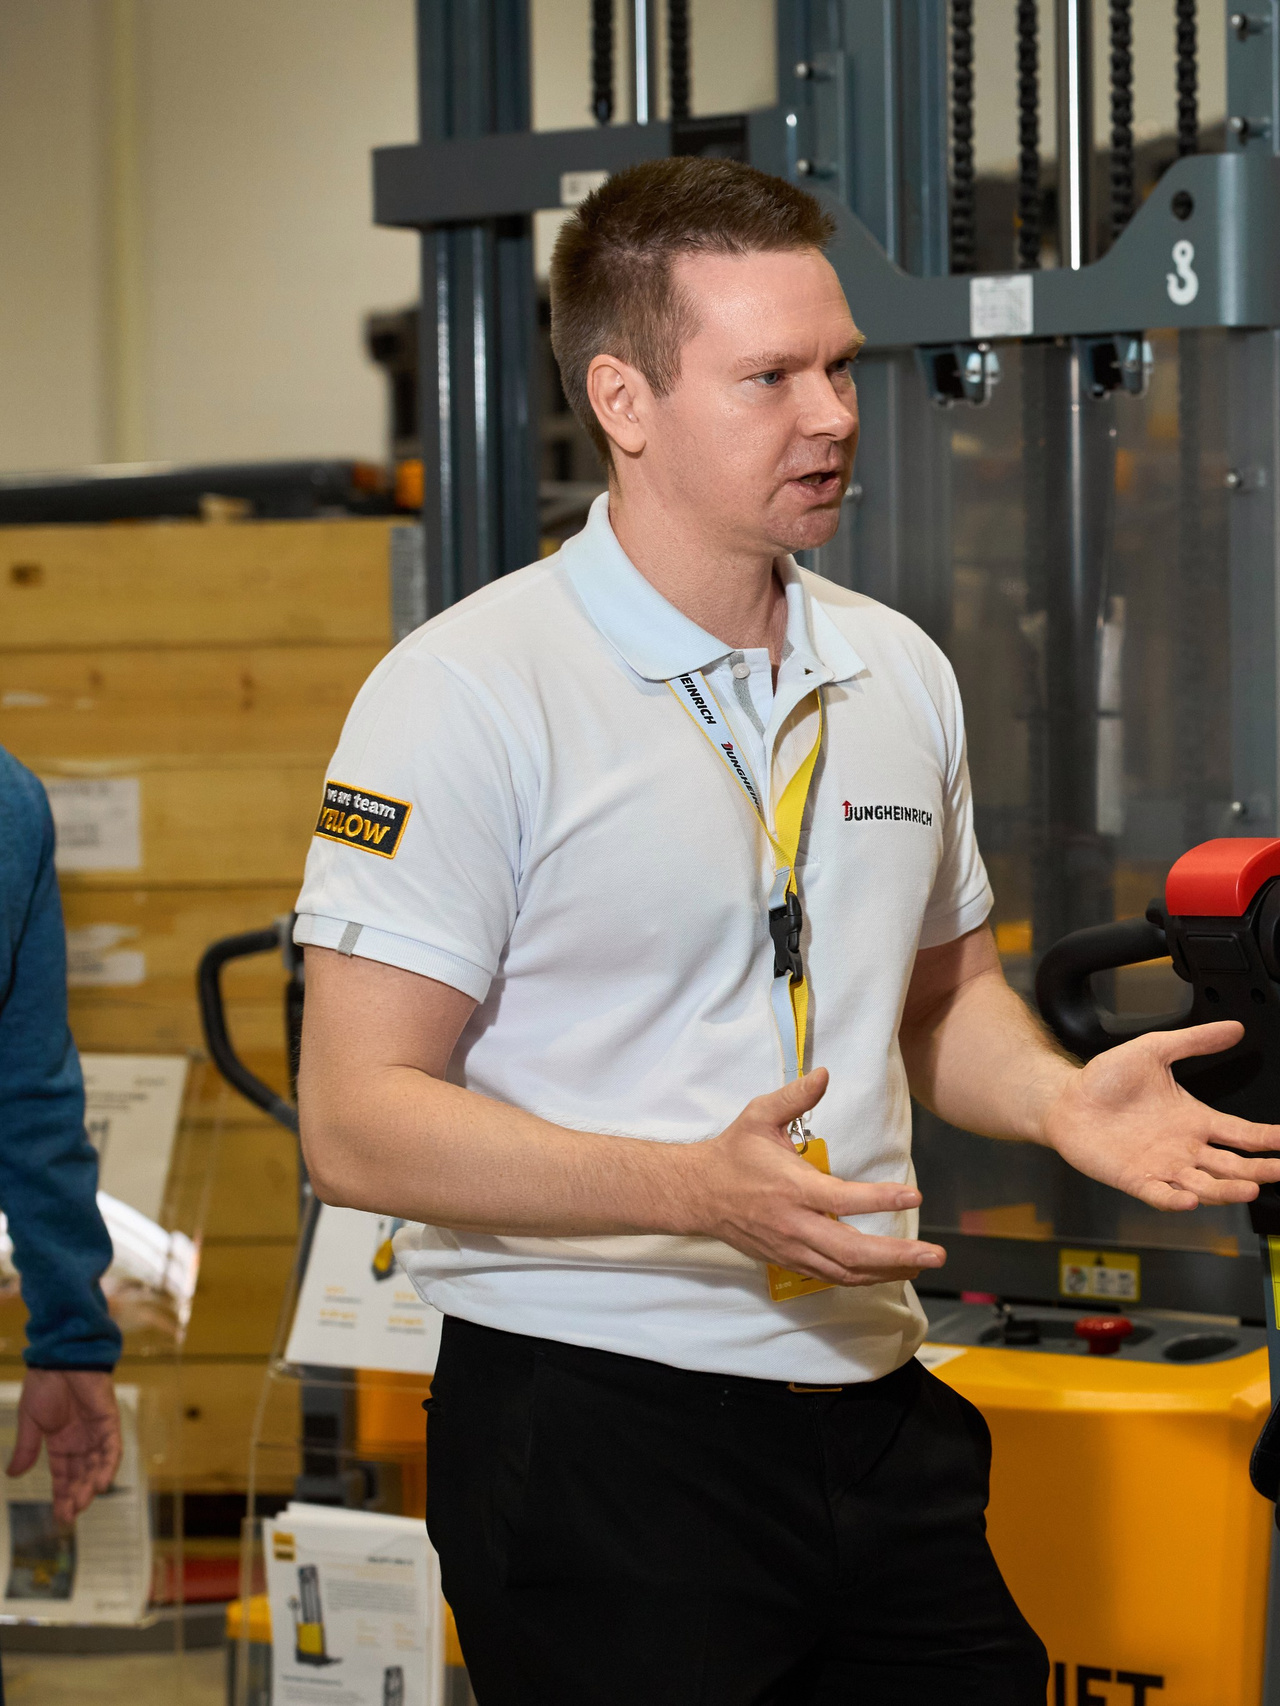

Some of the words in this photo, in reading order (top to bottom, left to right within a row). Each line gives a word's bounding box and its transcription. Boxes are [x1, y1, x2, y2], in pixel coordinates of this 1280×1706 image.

[721, 741, 762, 816] JUNGHEIN
[319, 806, 391, 845] YELLOW
[353, 793, 396, 820] team
[843, 802, 933, 827] JUNGHEINRICH
[1054, 1662, 1165, 1706] IFT
